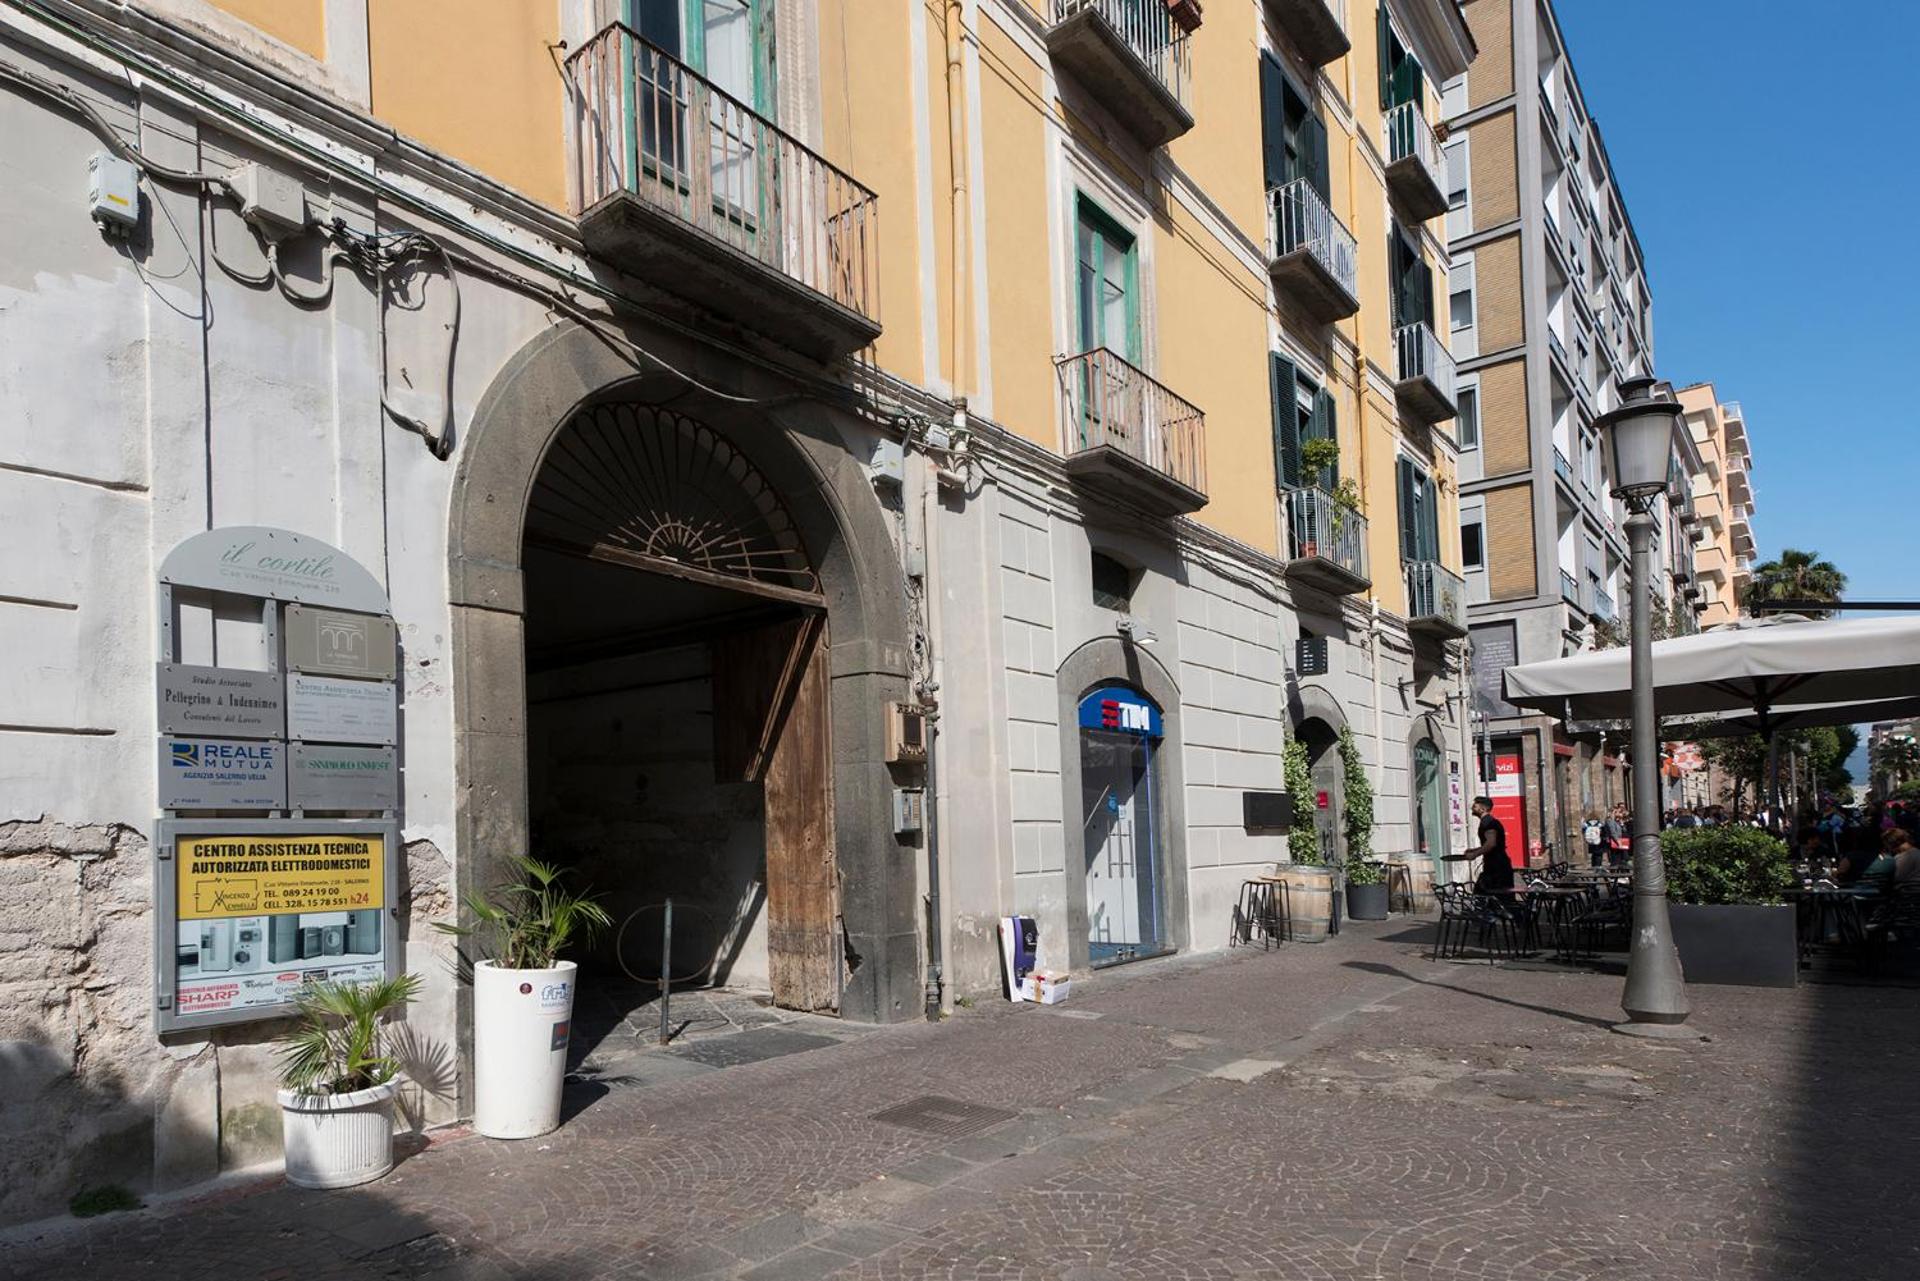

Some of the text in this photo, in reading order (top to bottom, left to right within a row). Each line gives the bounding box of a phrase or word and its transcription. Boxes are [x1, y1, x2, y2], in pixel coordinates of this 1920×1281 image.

[221, 542, 337, 578] il cortile
[165, 688, 211, 707] Pellegrino
[1119, 702, 1150, 731] TIM
[204, 744, 273, 760] REALE
[205, 760, 273, 769] MUTUA
[193, 842, 369, 857] CENTRO ASSISTENZA TECNICA
[192, 859, 370, 874] AUTORIZZATA ELETTRODOMESTICI
[264, 890, 279, 898] TEL.
[283, 889, 300, 897] 089
[302, 888, 313, 896] 24
[328, 887, 340, 895] 00
[350, 892, 369, 904] h24
[263, 901, 282, 909] CELL.
[308, 899, 318, 907] 15
[320, 898, 330, 906] 78
[176, 990, 240, 1004] SHARP
